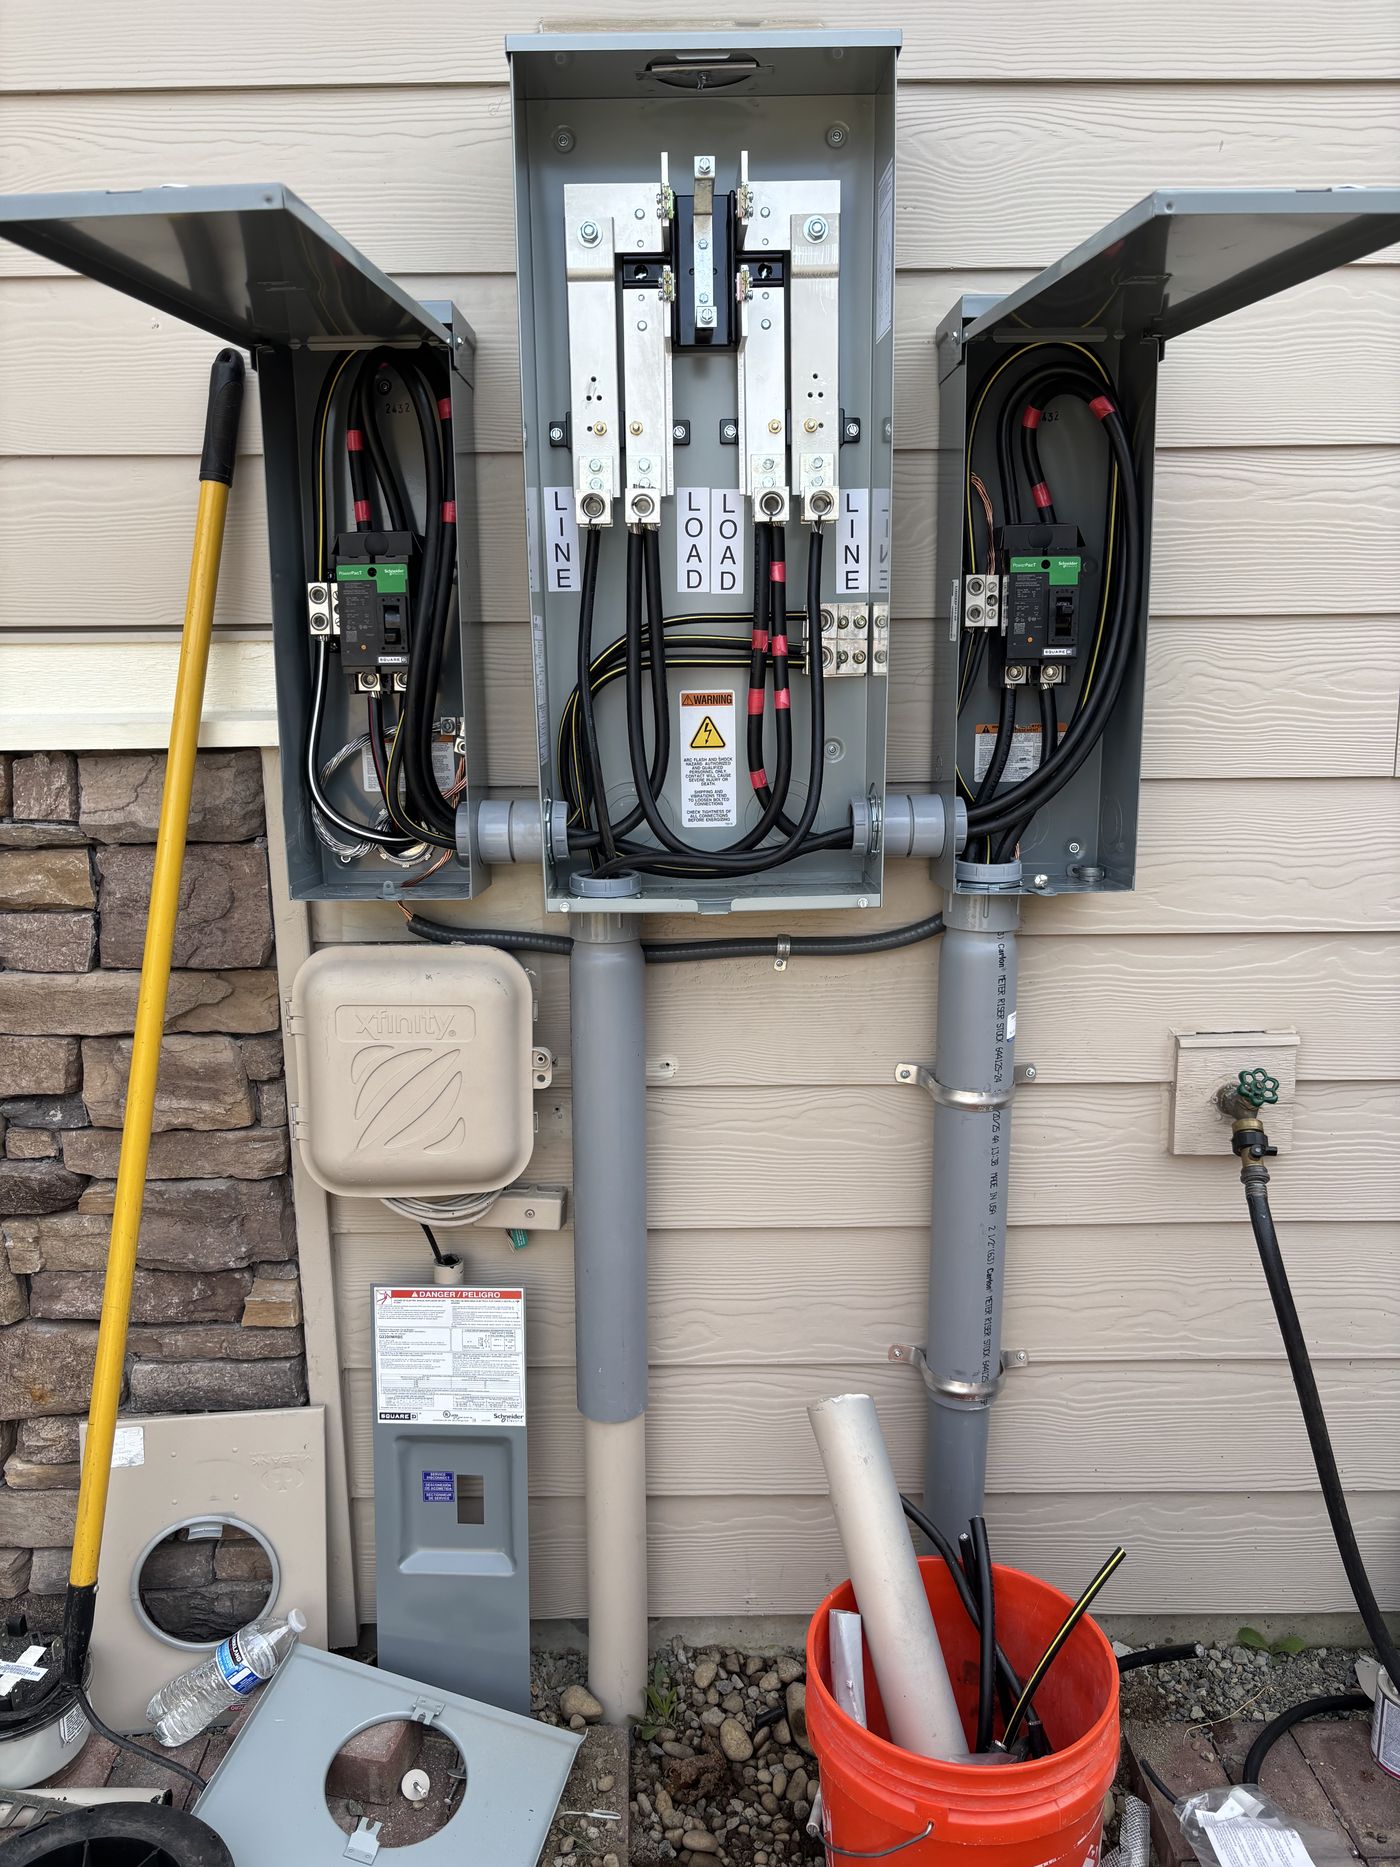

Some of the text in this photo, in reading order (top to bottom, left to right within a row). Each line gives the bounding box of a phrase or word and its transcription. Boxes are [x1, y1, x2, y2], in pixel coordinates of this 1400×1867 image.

[1041, 410, 1060, 423] 432
[554, 491, 572, 588] LINE
[684, 491, 704, 589] LOAD
[719, 493, 738, 591] LOAD
[844, 493, 860, 590] LINE
[693, 694, 733, 705] WARNING
[997, 974, 1006, 996] METER
[996, 998, 1006, 1020] RISER
[995, 1024, 1004, 1044] STOCK
[989, 1172, 998, 1189] MADE
[989, 1192, 998, 1200] IN
[988, 1202, 997, 1216] USA
[419, 1291, 456, 1299] DANGER
[462, 1291, 501, 1299] PELIGRO
[983, 1295, 993, 1315] METER
[983, 1317, 992, 1337] RISER
[982, 1339, 991, 1358] STOCK
